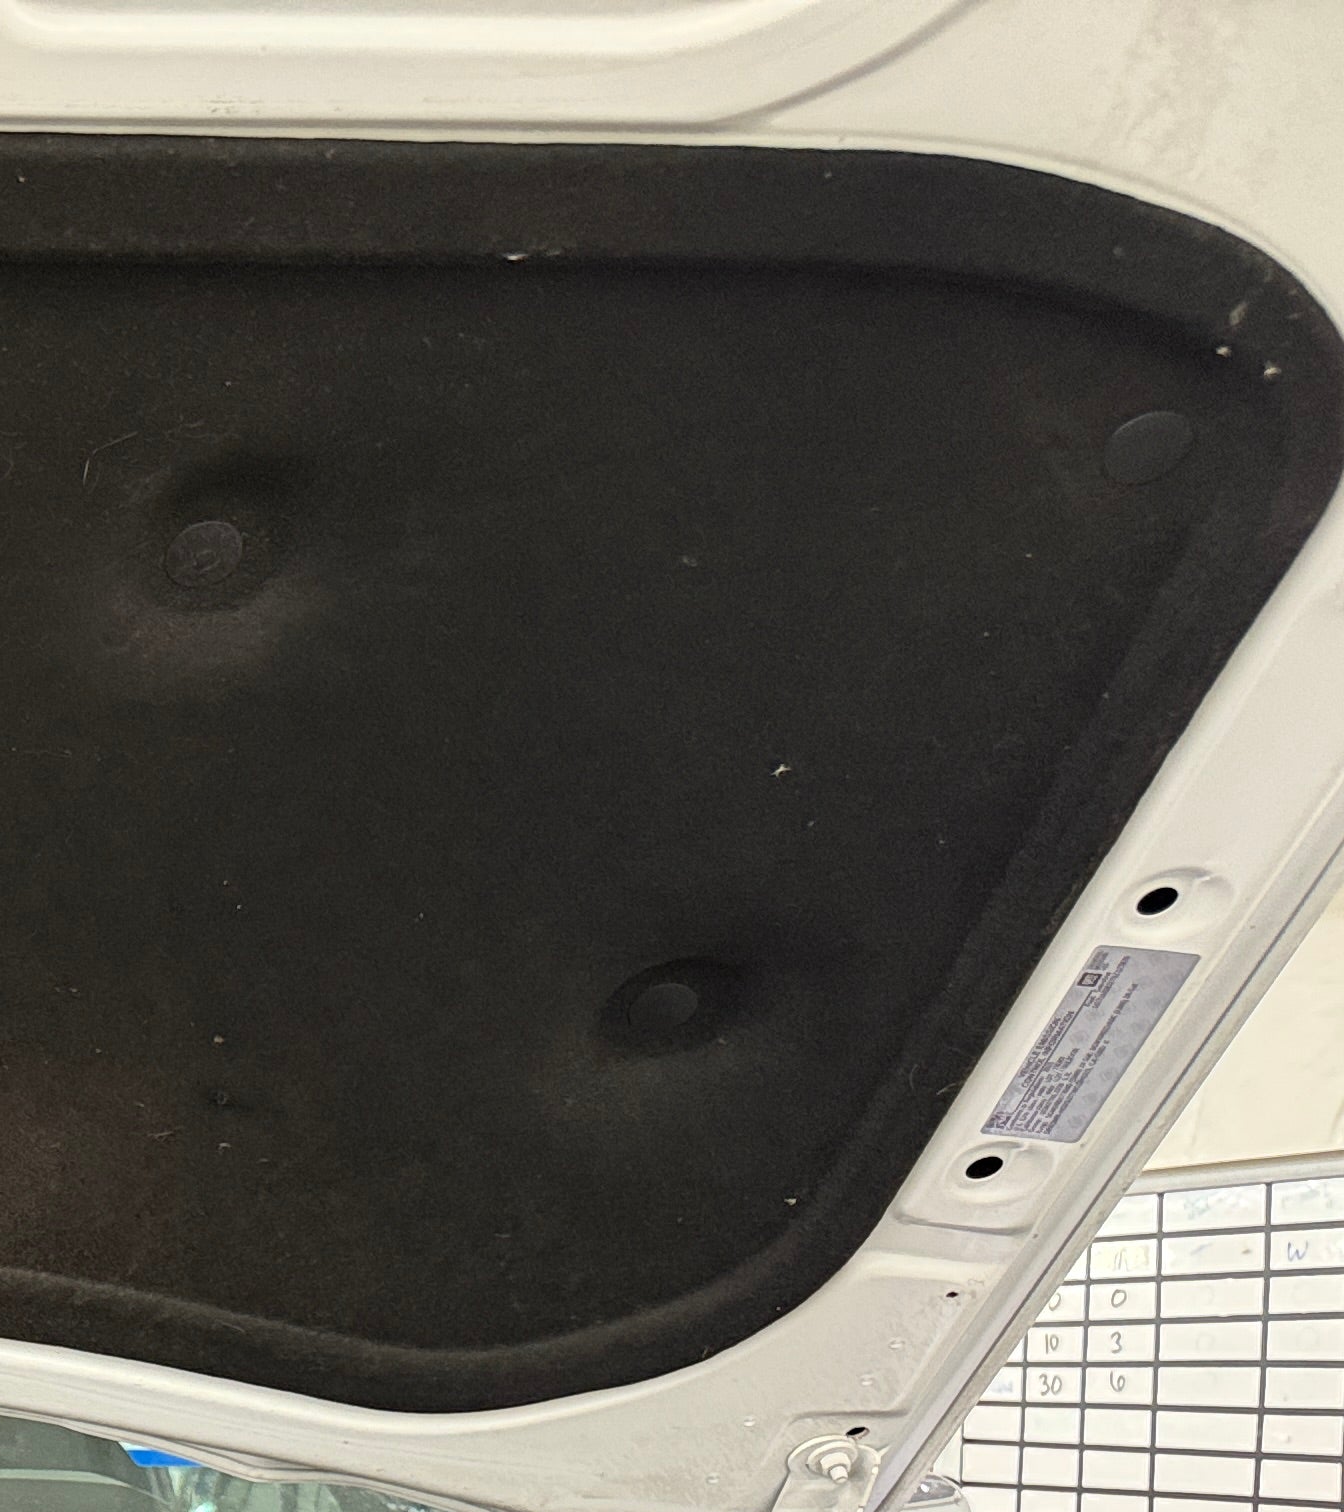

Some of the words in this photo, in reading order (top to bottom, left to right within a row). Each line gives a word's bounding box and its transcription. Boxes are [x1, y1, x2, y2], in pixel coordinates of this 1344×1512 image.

[1044, 1333, 1060, 1354] 10
[1110, 1331, 1123, 1354] 3
[1038, 1373, 1063, 1397] 30
[1109, 1370, 1126, 1393] 6
